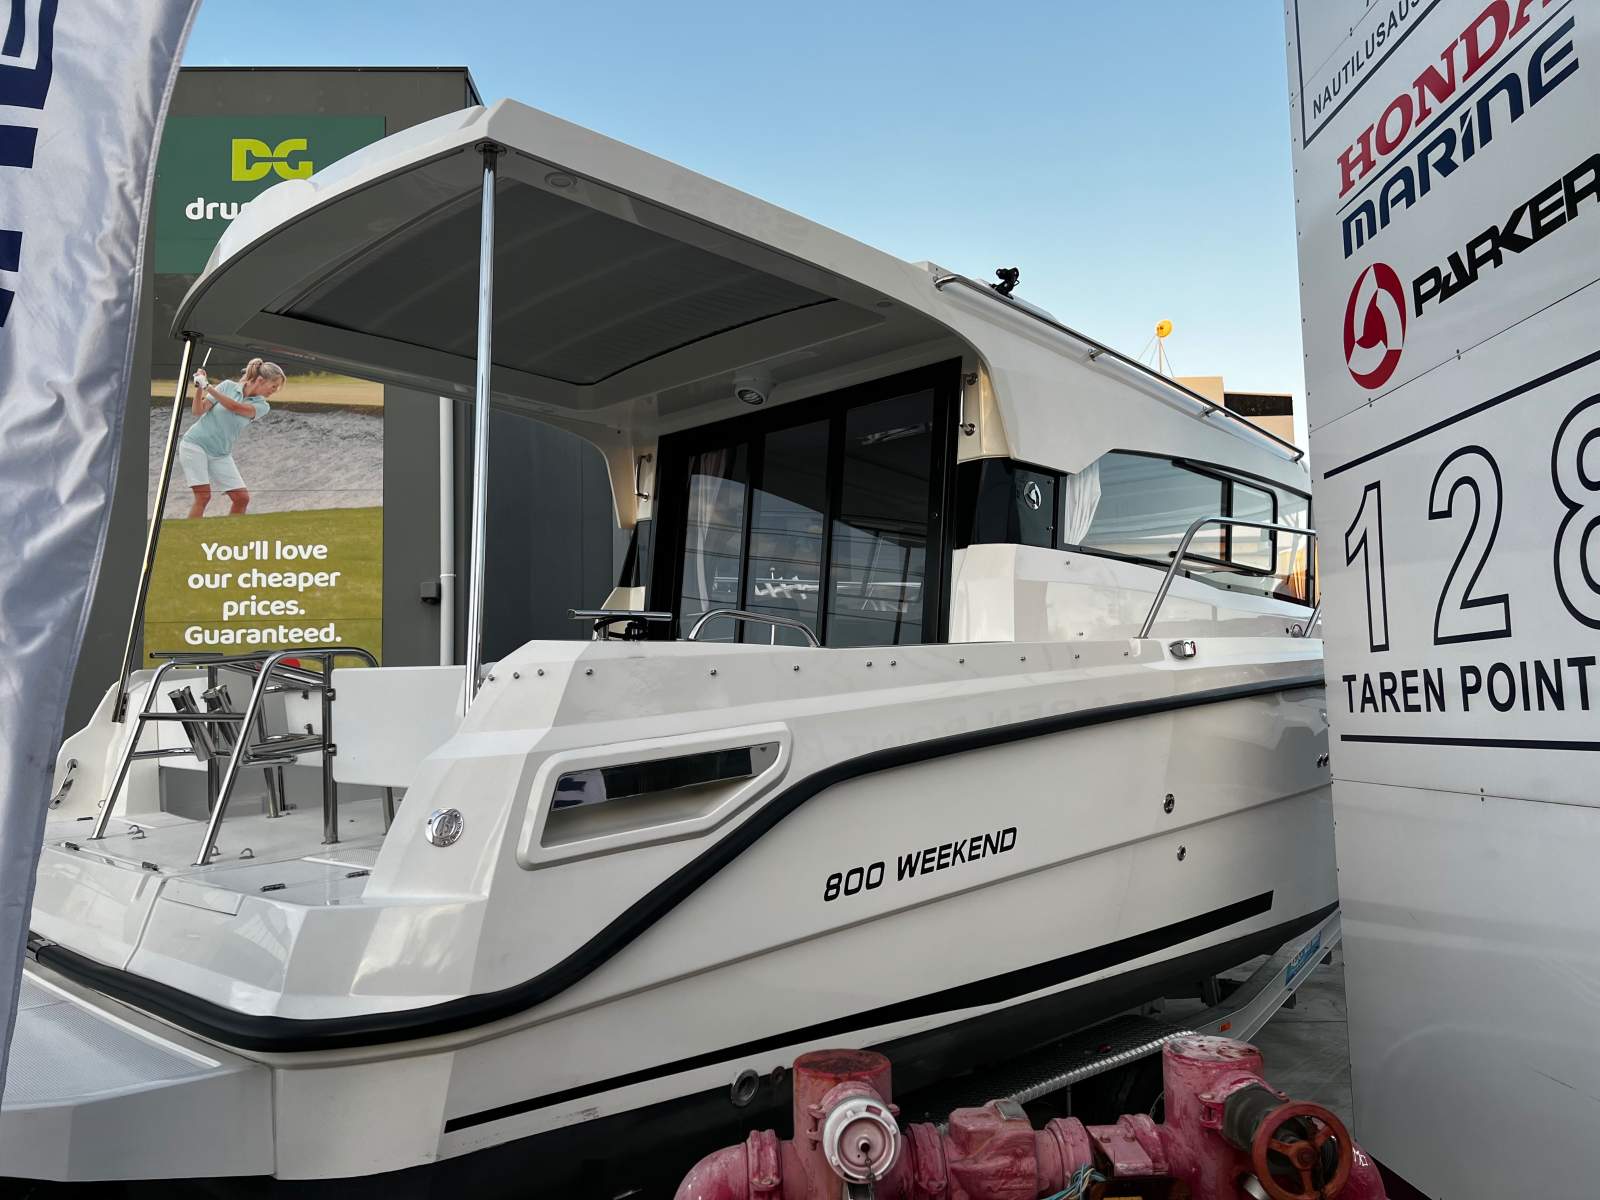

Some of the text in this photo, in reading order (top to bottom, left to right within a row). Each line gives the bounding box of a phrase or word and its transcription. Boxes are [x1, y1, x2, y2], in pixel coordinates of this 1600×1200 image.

[1342, 16, 1580, 260] MARINE
[231, 138, 313, 182] DG
[185, 197, 250, 220] dru
[201, 540, 328, 561] You'll love
[187, 568, 341, 592] our cheaper
[222, 595, 305, 620] prices.
[184, 623, 342, 645] Guaranteed.
[1343, 656, 1596, 713] TAREN POINT
[824, 827, 1017, 901] 800 WEEKEND
